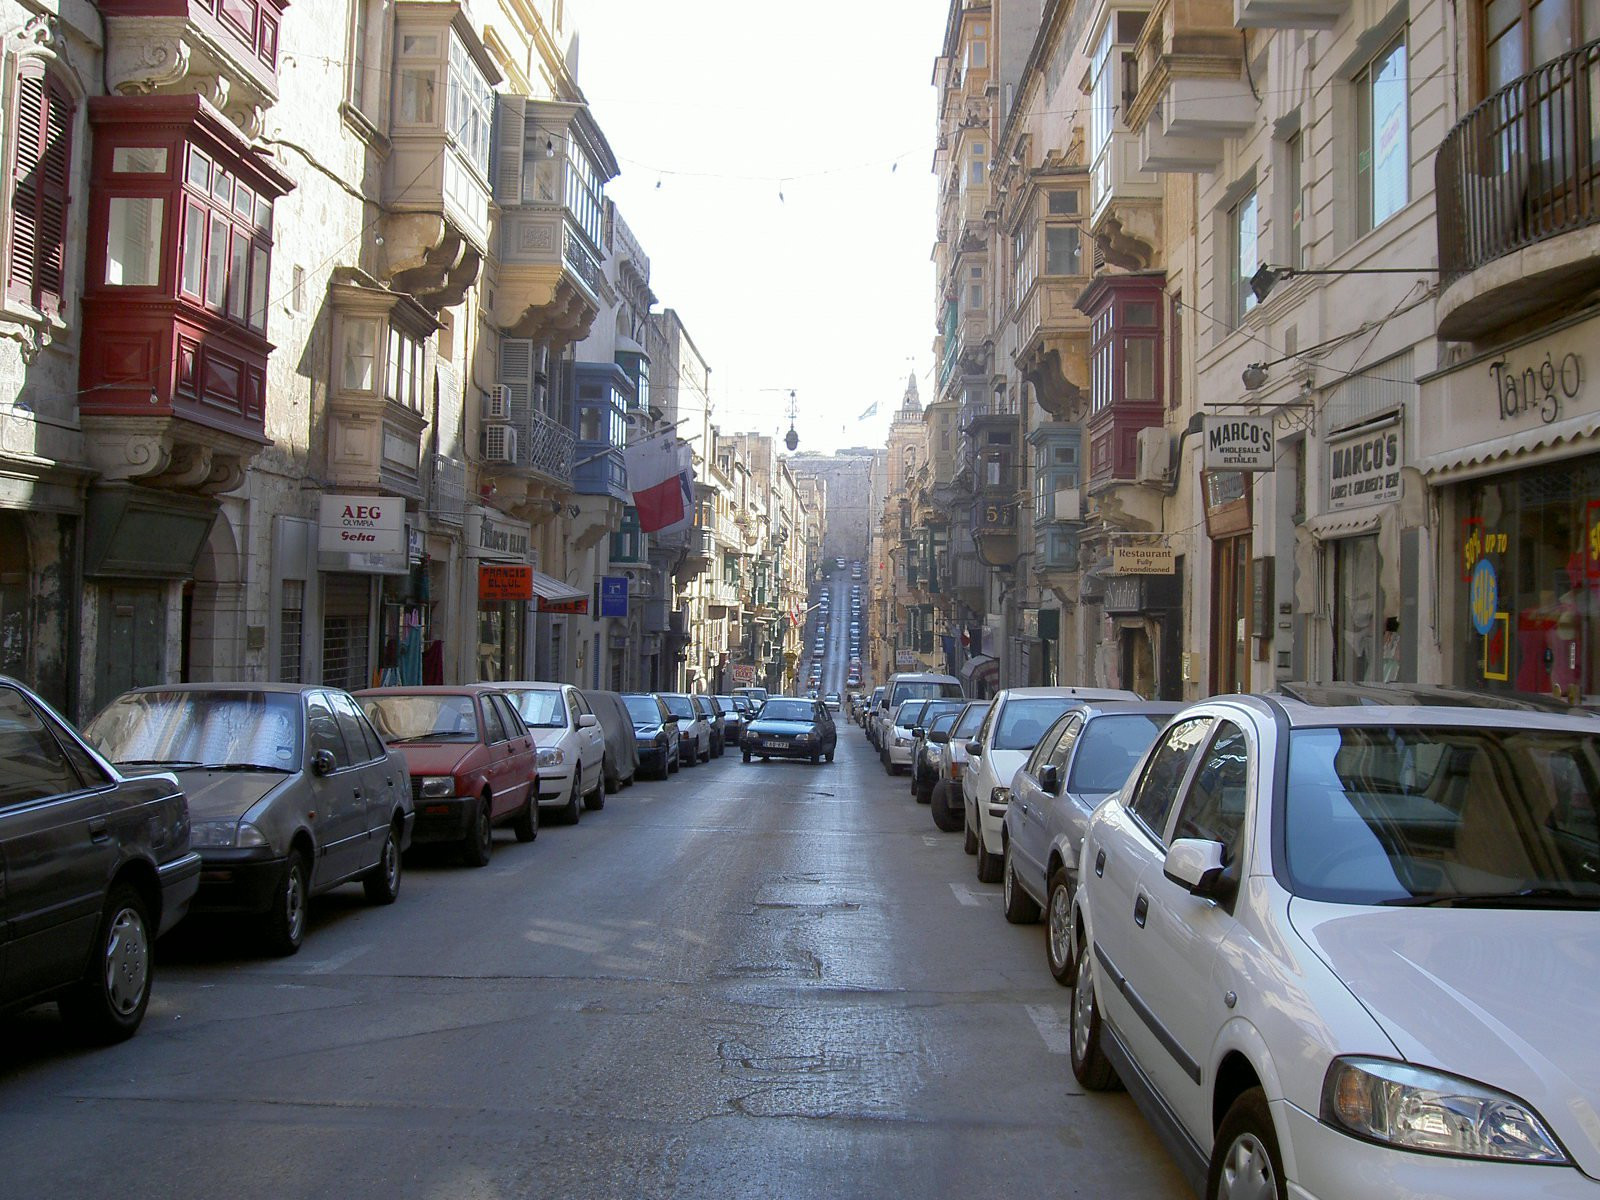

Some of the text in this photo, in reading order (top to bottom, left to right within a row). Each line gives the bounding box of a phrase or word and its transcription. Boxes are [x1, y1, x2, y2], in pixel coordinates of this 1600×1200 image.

[1489, 352, 1580, 424] Tango
[1209, 422, 1271, 452] MARCO'S
[1332, 432, 1397, 479] MARCO'S
[341, 505, 382, 519] AEG
[343, 519, 375, 527] OLYMPIA
[341, 531, 376, 542] Geha
[1485, 534, 1496, 553] UP
[1496, 533, 1507, 553] TO
[1119, 549, 1172, 558] Restaurant
[1136, 558, 1153, 566] Fully
[482, 568, 526, 578] FRANCIS
[1473, 568, 1495, 625] SALE
